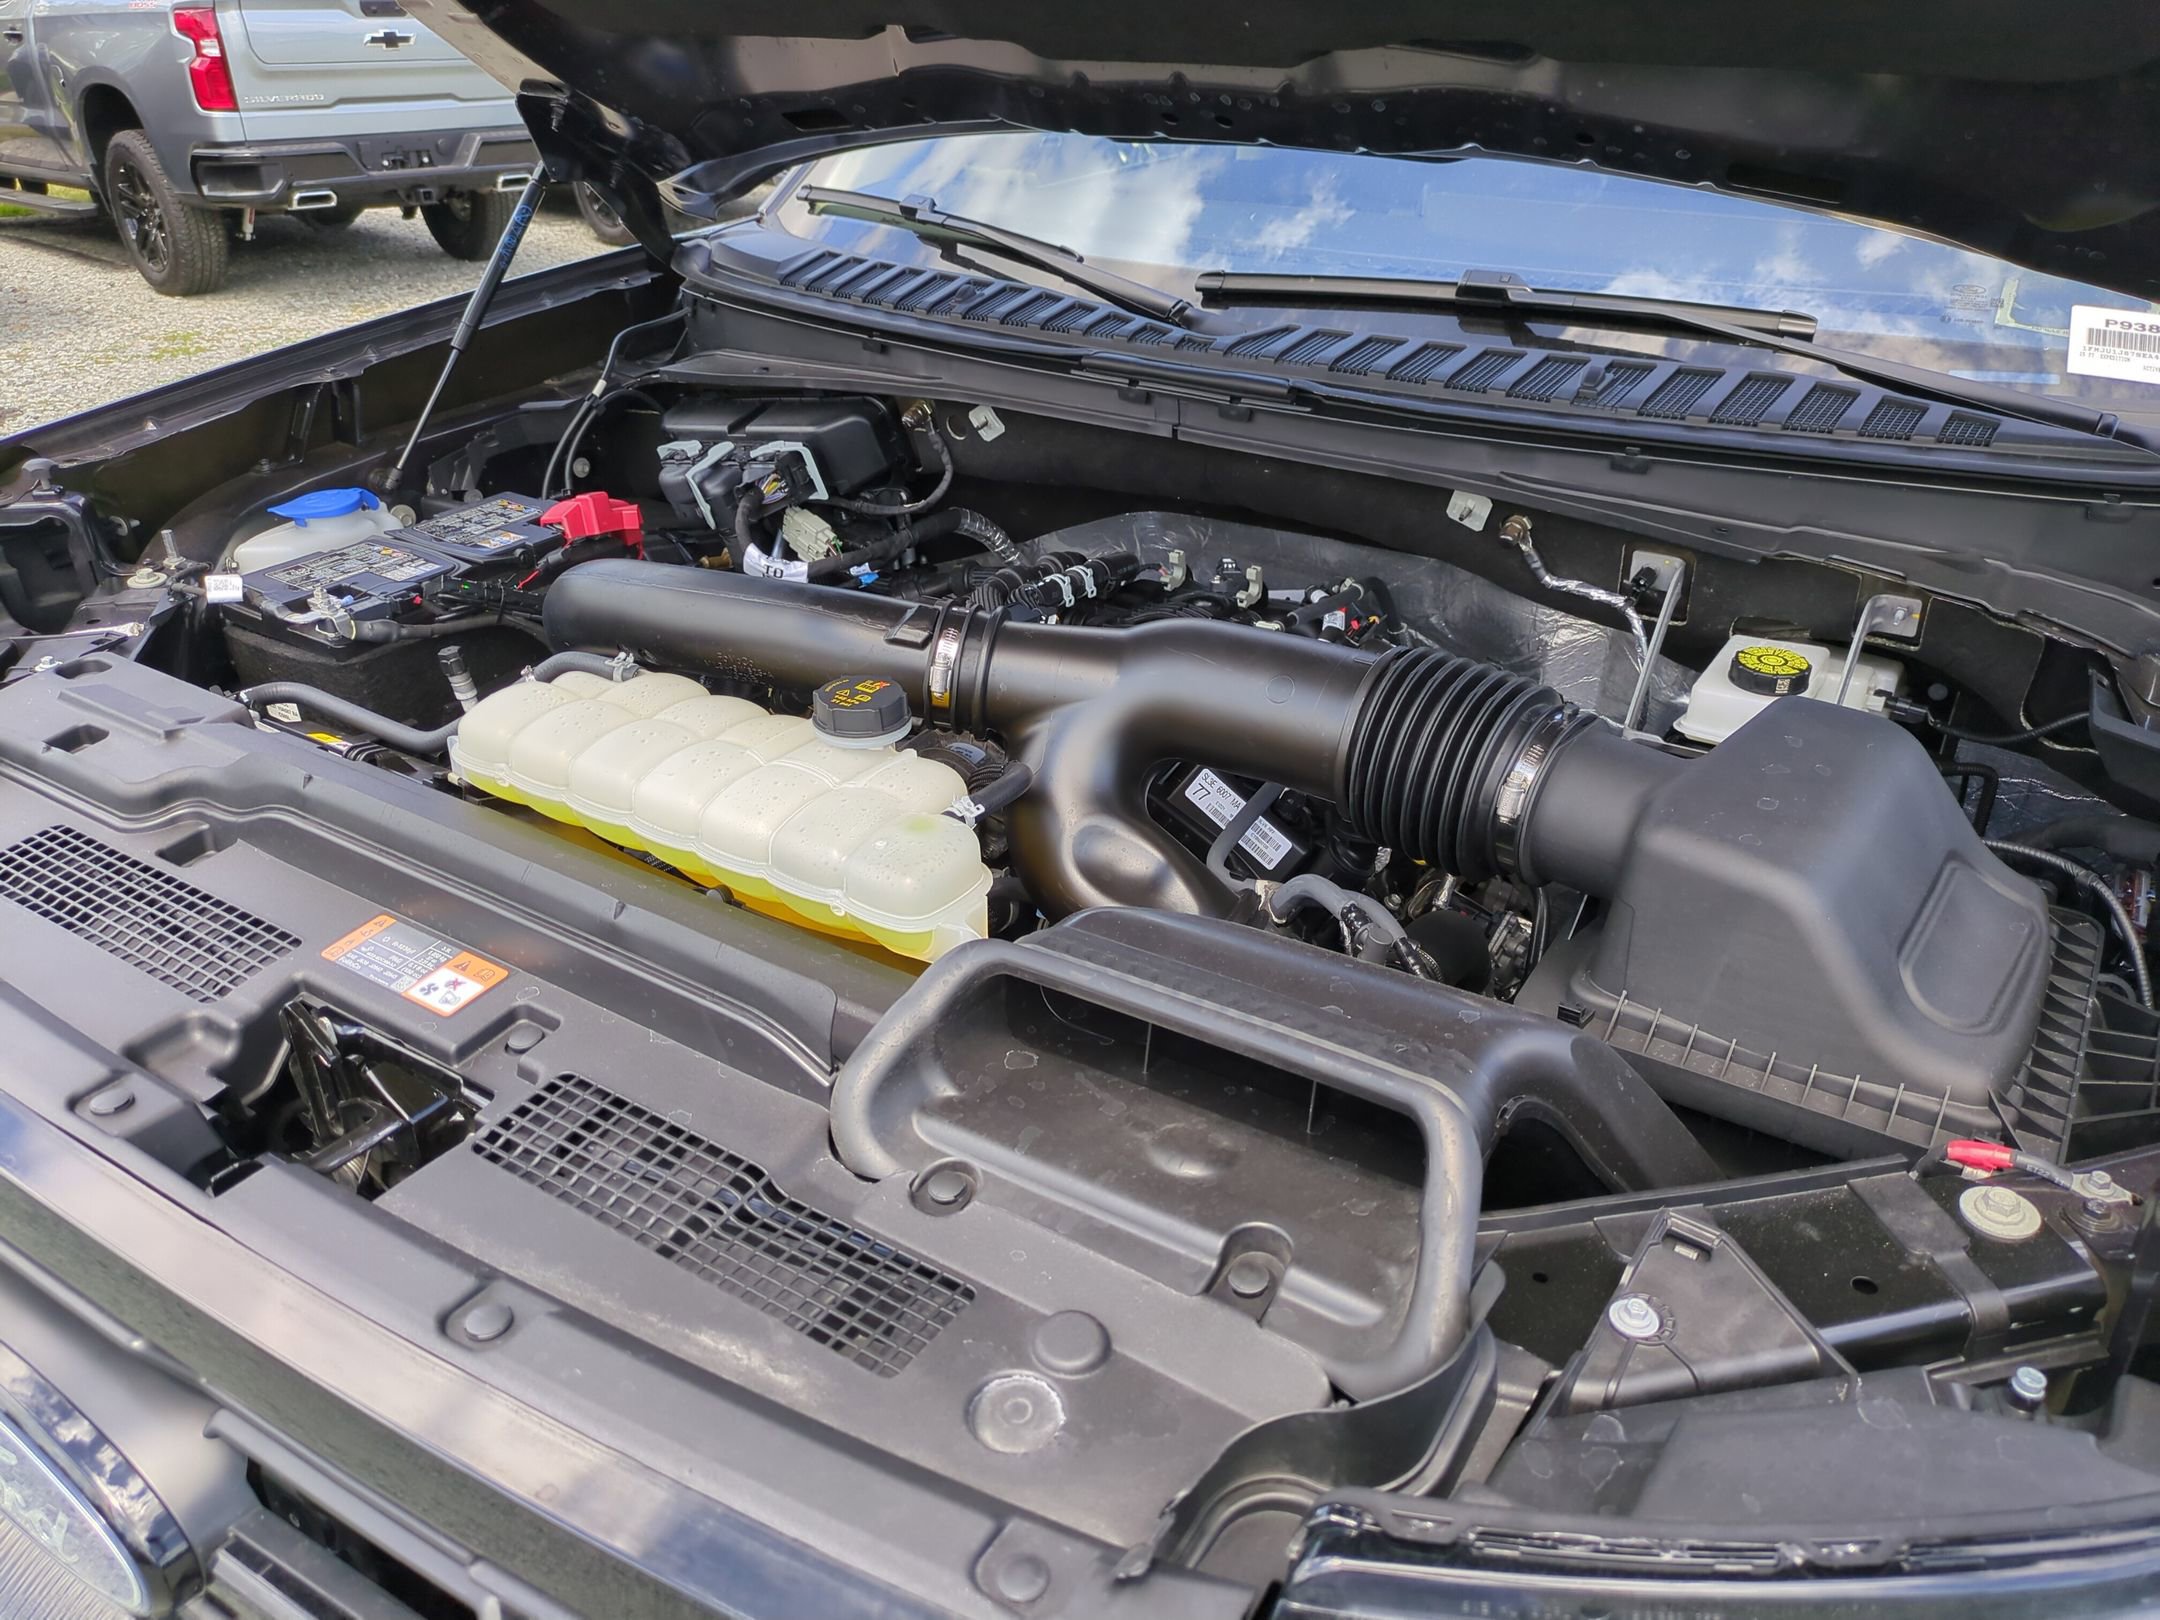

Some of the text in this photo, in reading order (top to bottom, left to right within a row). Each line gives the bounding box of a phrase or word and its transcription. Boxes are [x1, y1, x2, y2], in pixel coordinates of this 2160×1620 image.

[1192, 782, 1211, 801] 77
[1216, 786, 1232, 800] 6007
[1230, 798, 1242, 810] MA
